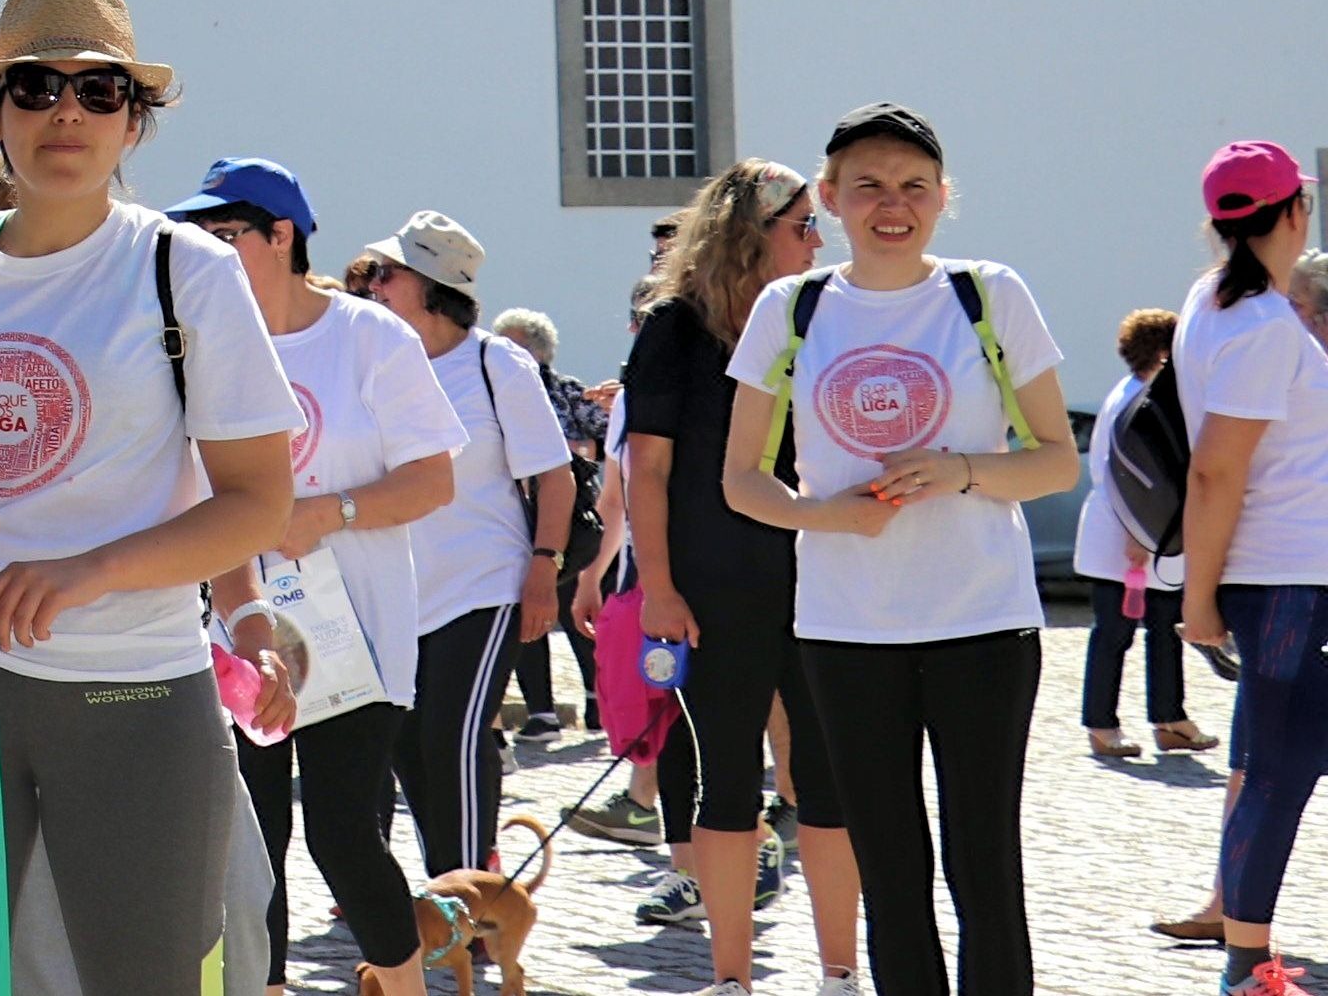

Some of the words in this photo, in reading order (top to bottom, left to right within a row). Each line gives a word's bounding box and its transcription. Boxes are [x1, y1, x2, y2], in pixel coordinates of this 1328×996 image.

[25, 378, 59, 390] AFETO
[861, 398, 899, 412] LIGA
[46, 426, 60, 453] VIDA
[272, 589, 305, 606] OMB
[84, 685, 172, 698] FUNCTIONAL
[86, 689, 173, 704] WORKOUT
